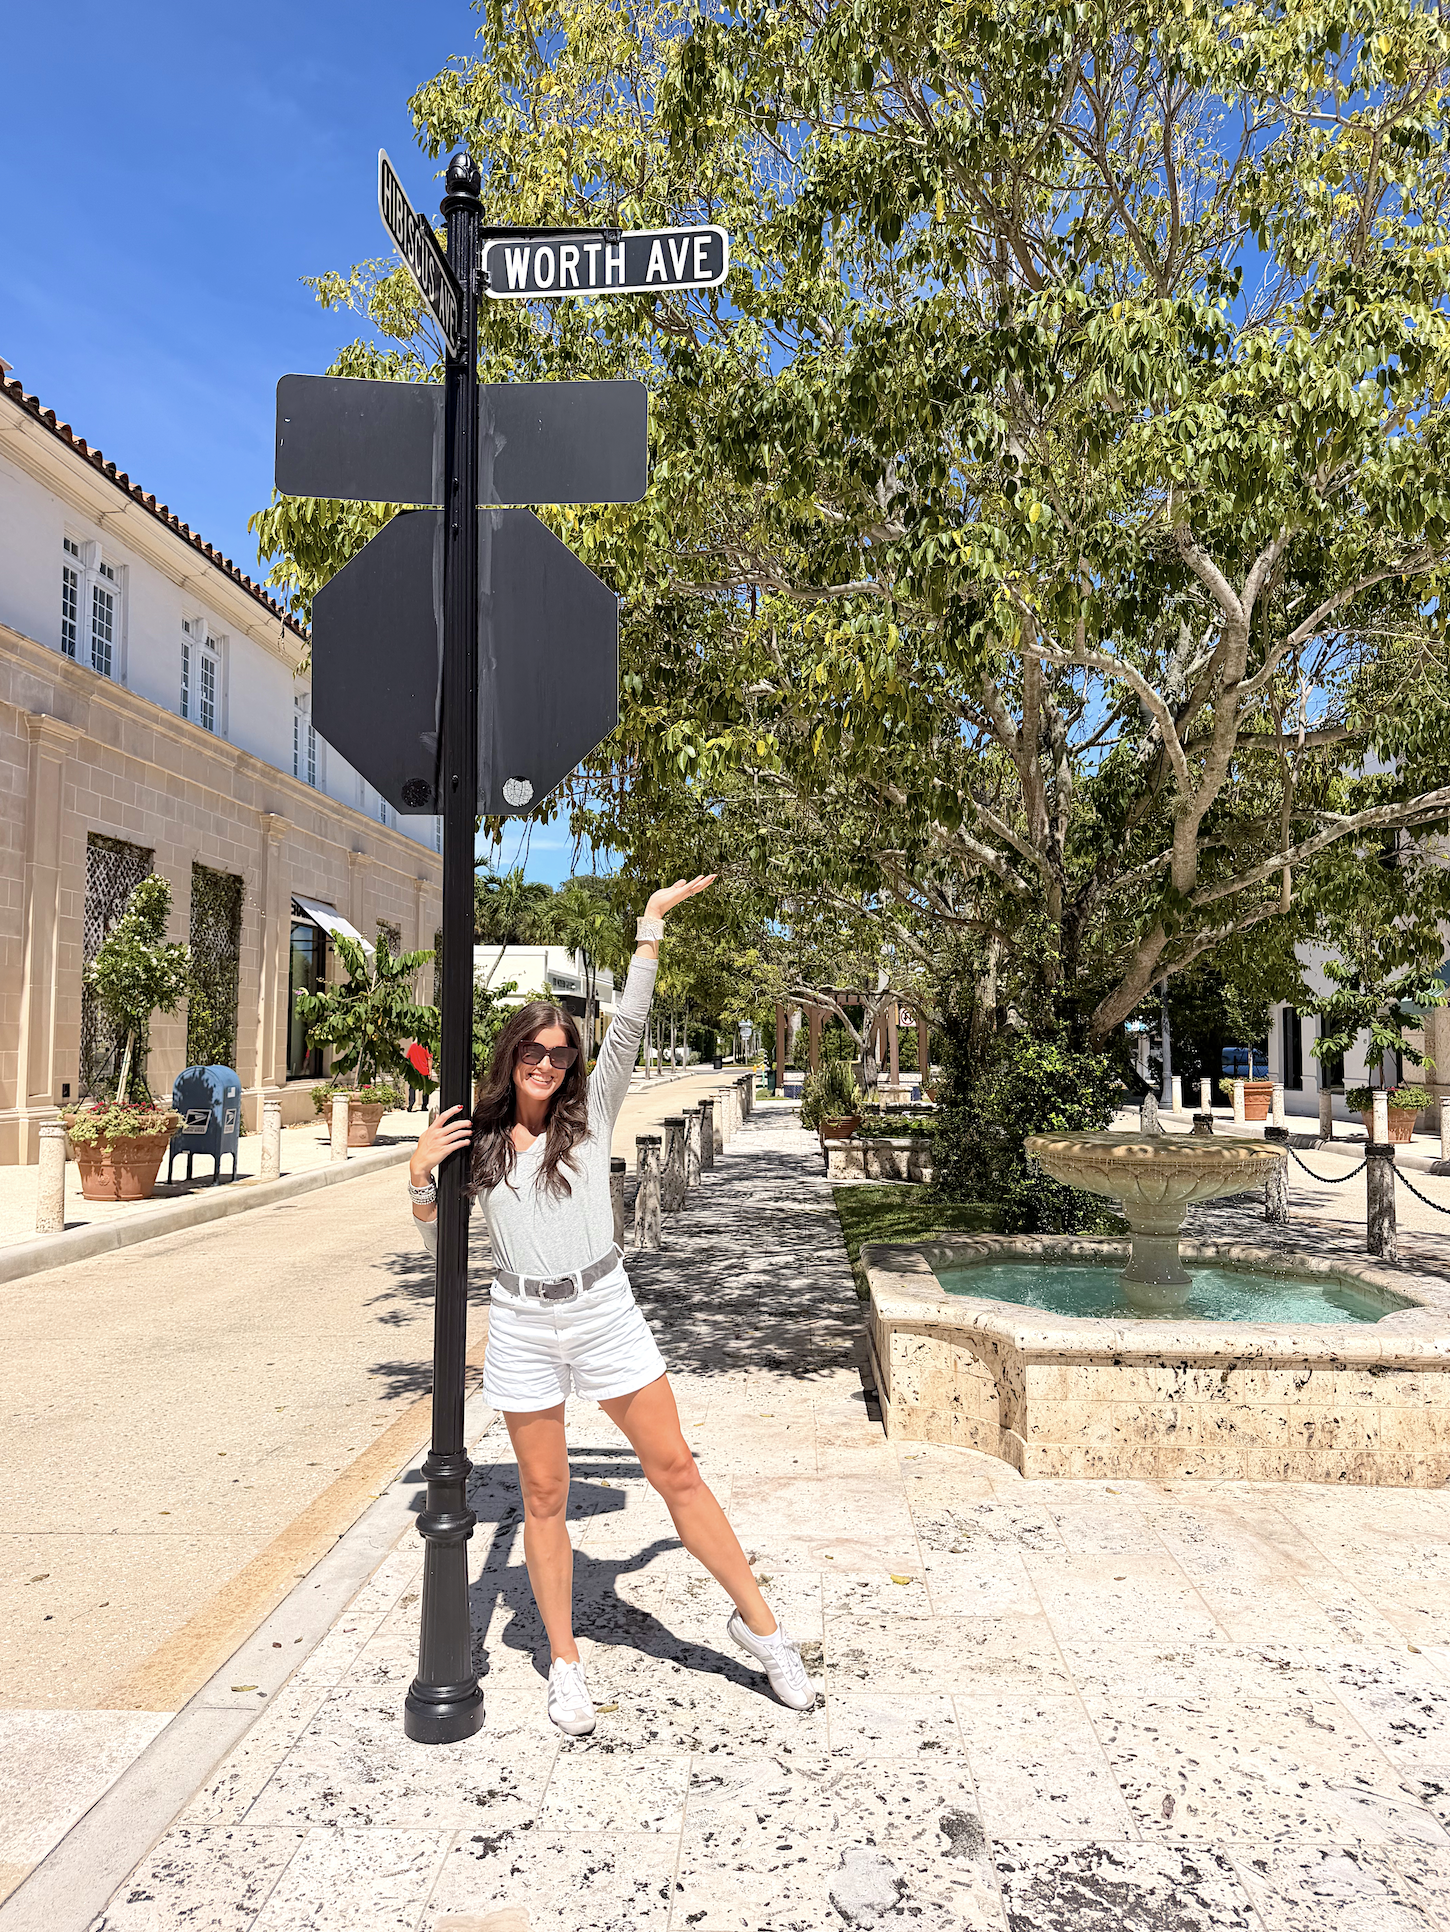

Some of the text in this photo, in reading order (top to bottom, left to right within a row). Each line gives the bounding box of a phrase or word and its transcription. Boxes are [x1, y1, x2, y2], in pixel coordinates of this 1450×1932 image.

[383, 163, 455, 347] HIBISCUS AVE
[504, 235, 713, 290] WORTH AVE
